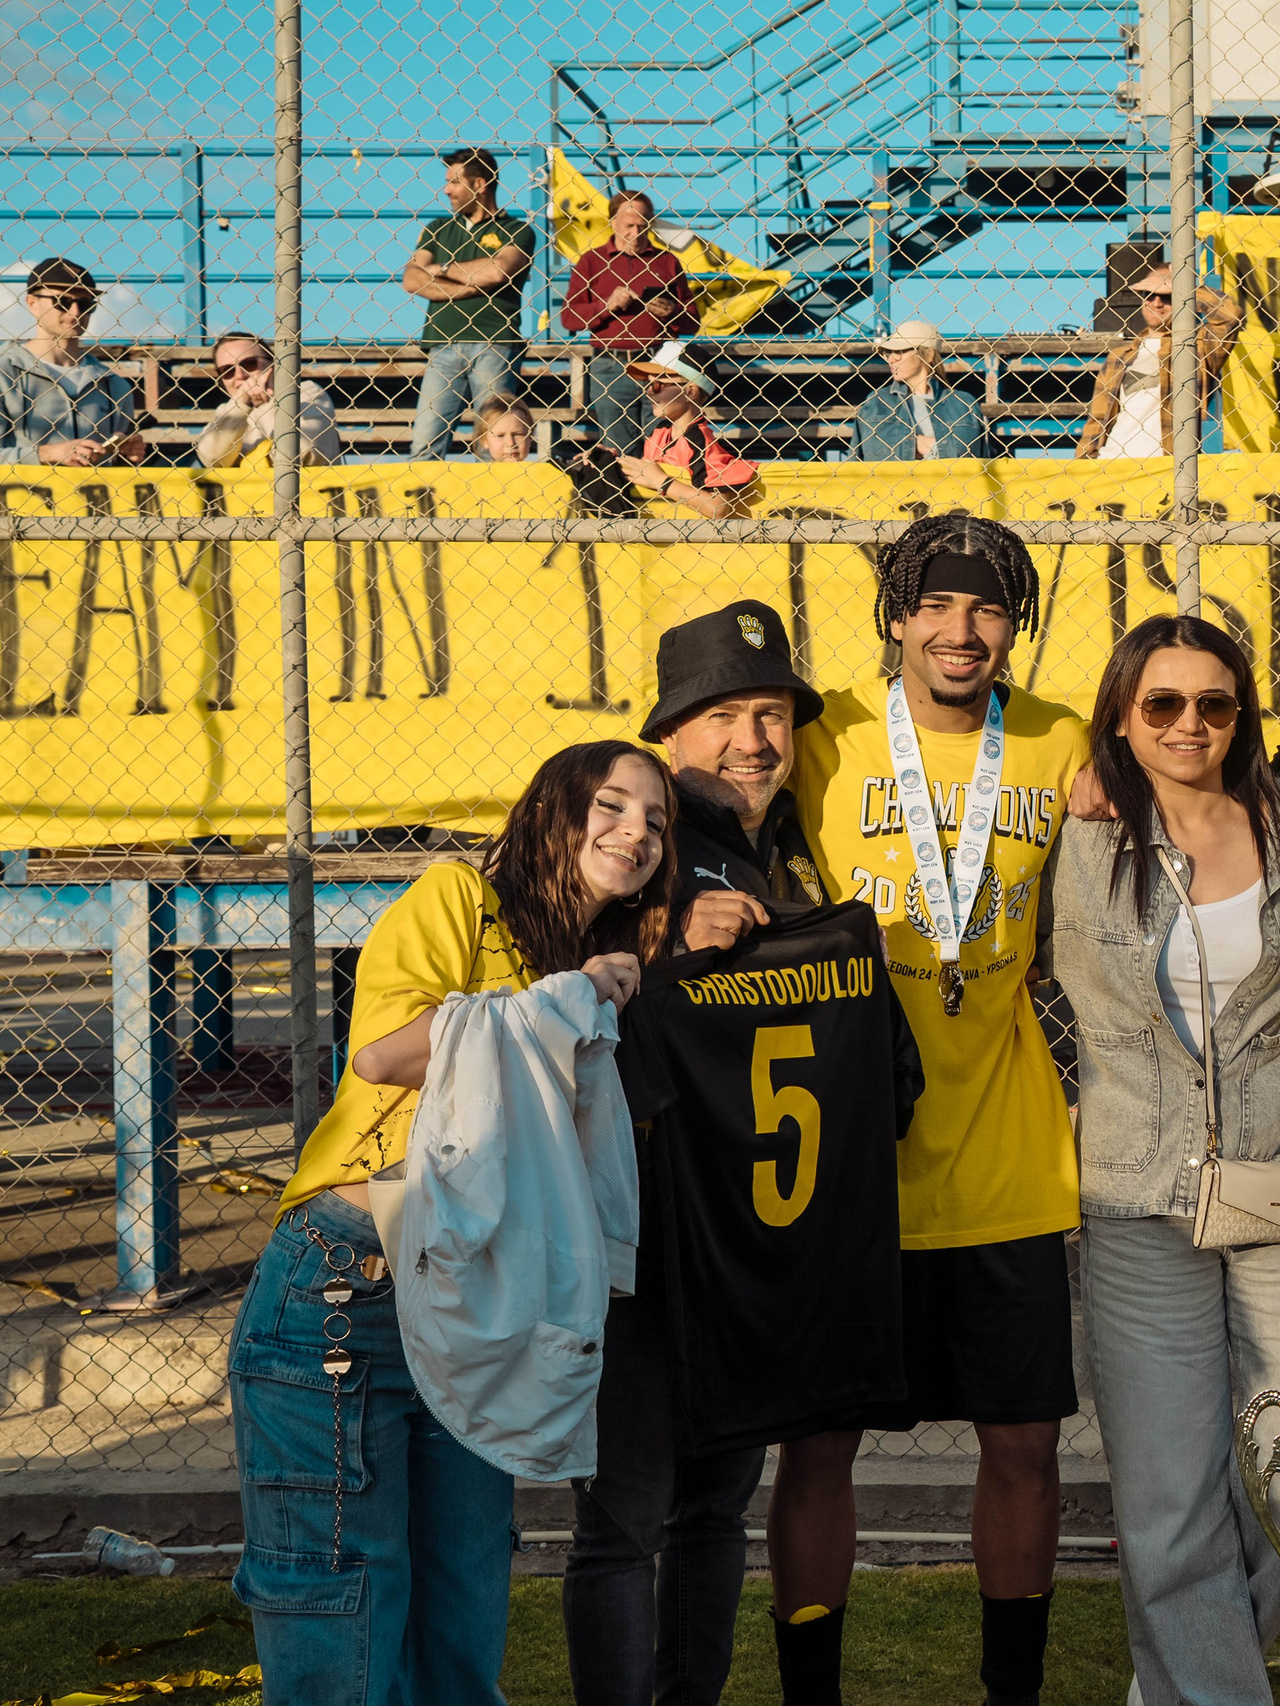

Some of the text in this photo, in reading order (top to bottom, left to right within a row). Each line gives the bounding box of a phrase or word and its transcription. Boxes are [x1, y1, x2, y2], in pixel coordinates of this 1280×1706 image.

[859, 775, 1056, 849] CHMONS
[851, 866, 897, 915] 20
[677, 957, 873, 1006] CHRISTODOULOU
[920, 968, 932, 981] 24
[986, 951, 1018, 976] YPSONAS
[751, 1024, 821, 1227] 5
